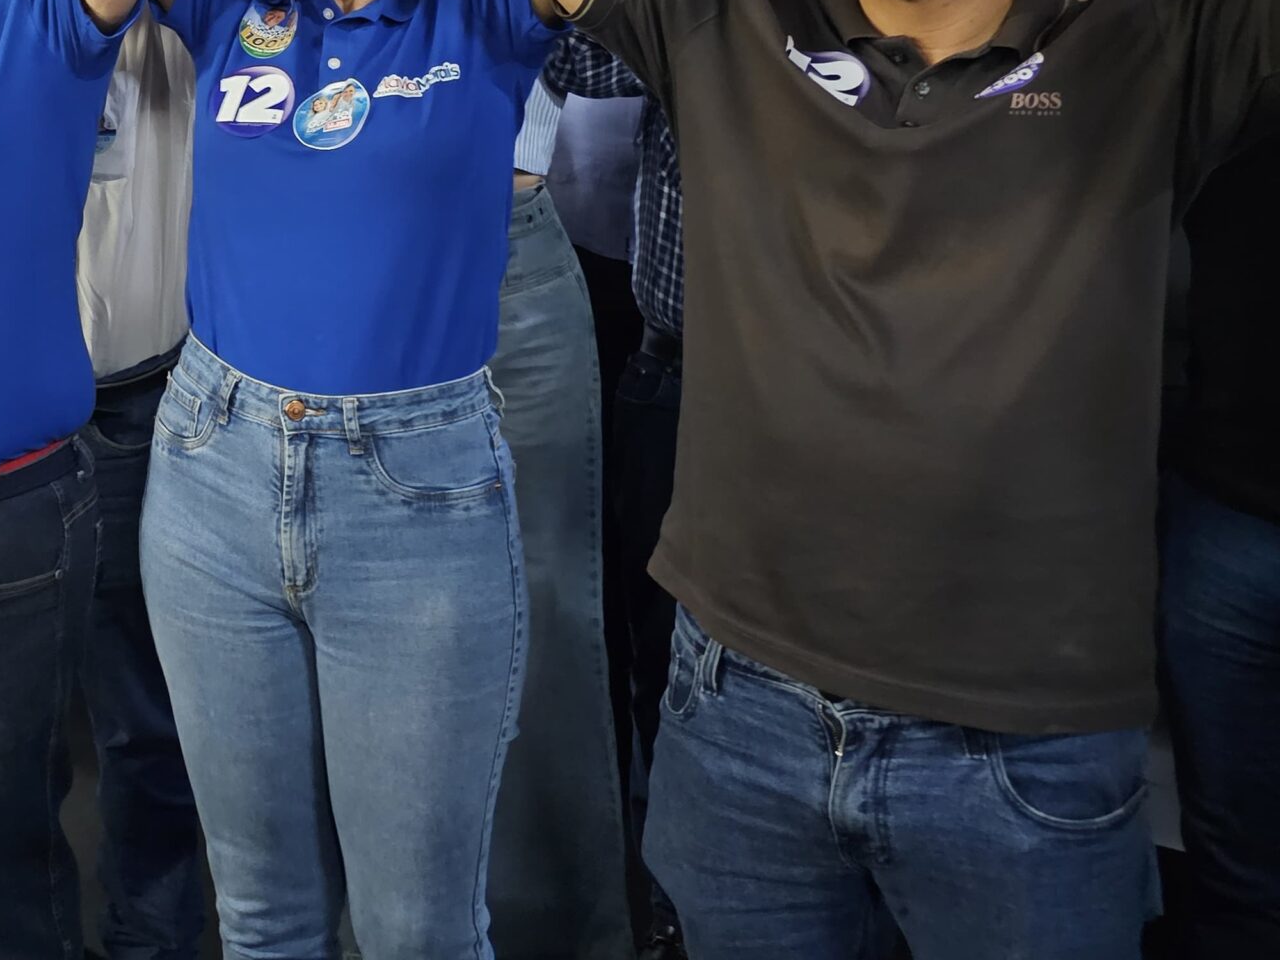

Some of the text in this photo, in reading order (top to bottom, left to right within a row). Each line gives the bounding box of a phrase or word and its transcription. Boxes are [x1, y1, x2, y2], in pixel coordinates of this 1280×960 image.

[785, 35, 865, 107] 12
[215, 74, 291, 125] 12
[1009, 92, 1062, 109] BOSS
